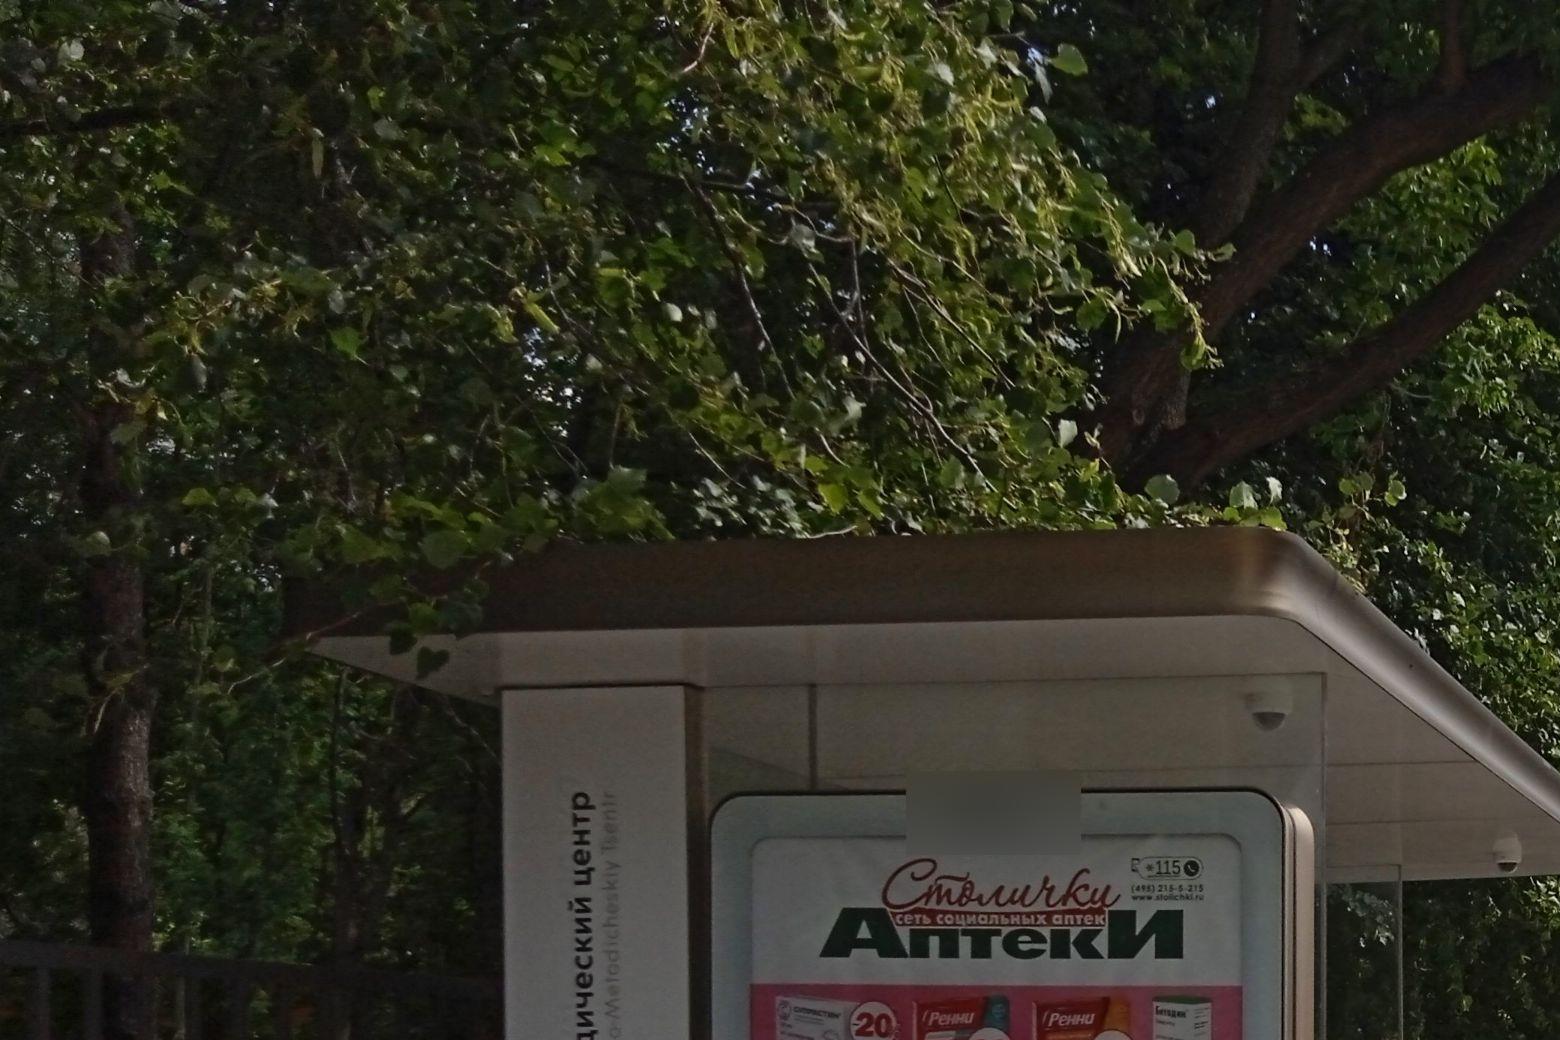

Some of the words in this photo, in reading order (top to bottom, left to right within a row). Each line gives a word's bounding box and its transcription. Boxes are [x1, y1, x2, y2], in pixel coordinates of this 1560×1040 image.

[571, 790, 597, 886] центр
[881, 857, 1122, 911] Столички
[895, 912, 932, 926] сеть
[936, 913, 1047, 927] социальных
[1052, 914, 1105, 926] аптек
[928, 1012, 975, 1027] Ренни
[1048, 1012, 1096, 1028] Ренни
